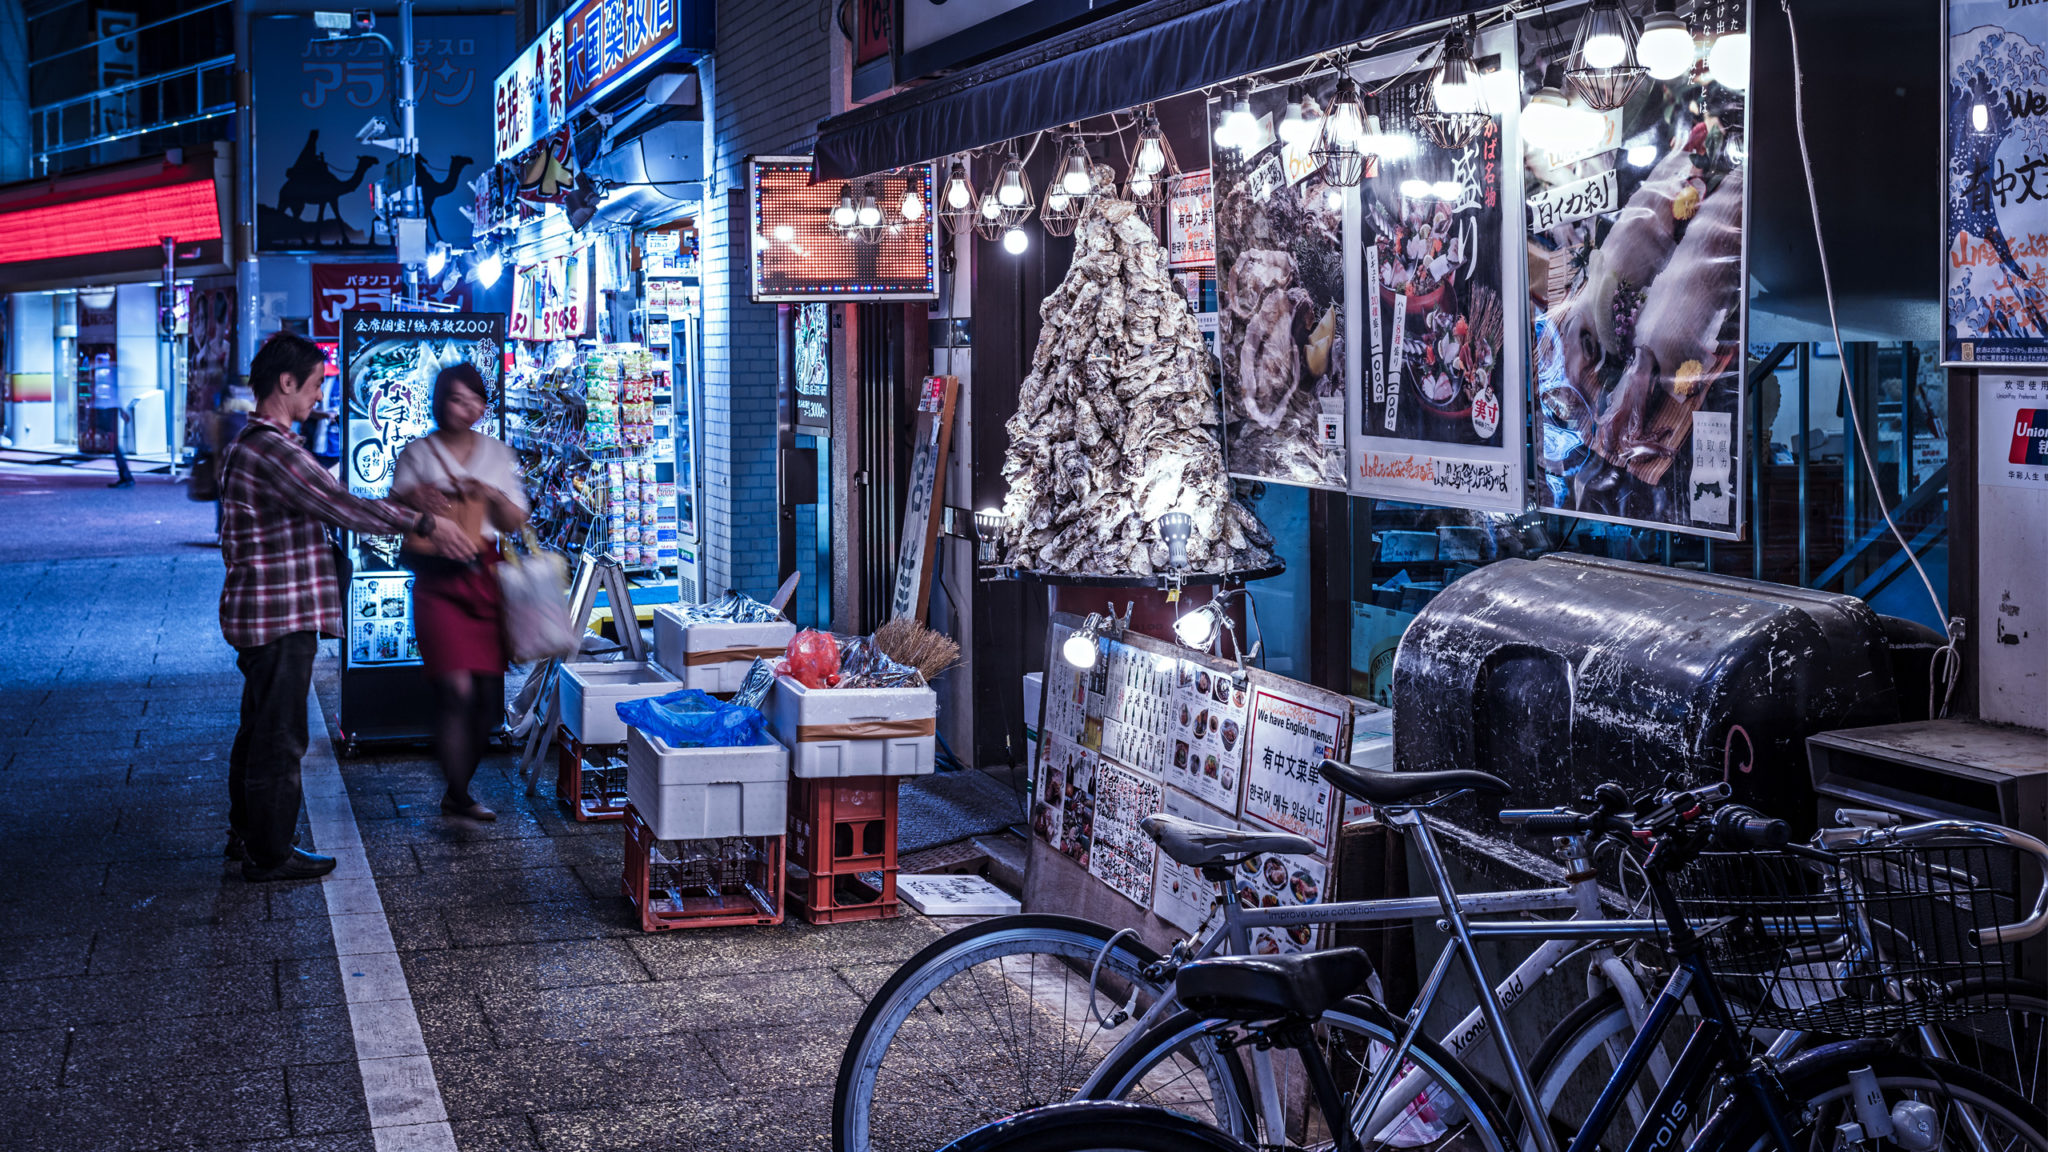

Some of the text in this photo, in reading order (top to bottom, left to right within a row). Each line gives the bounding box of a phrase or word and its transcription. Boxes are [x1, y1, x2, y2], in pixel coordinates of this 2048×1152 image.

[1960, 154, 2048, 213] 有中文
[345, 275, 390, 287] パチンコ
[1697, 455, 1727, 468] 白イカ
[1257, 708, 1268, 722] We
[1268, 713, 1285, 728] have
[1285, 718, 1308, 736] English
[1309, 728, 1334, 746] menus.
[1263, 746, 1319, 787] 有中文菜单
[1249, 784, 1271, 808] 한국어
[1272, 793, 1289, 816] 메뉴
[1291, 800, 1326, 830] 있습니다.
[1450, 974, 1524, 1055] Xronu ield
